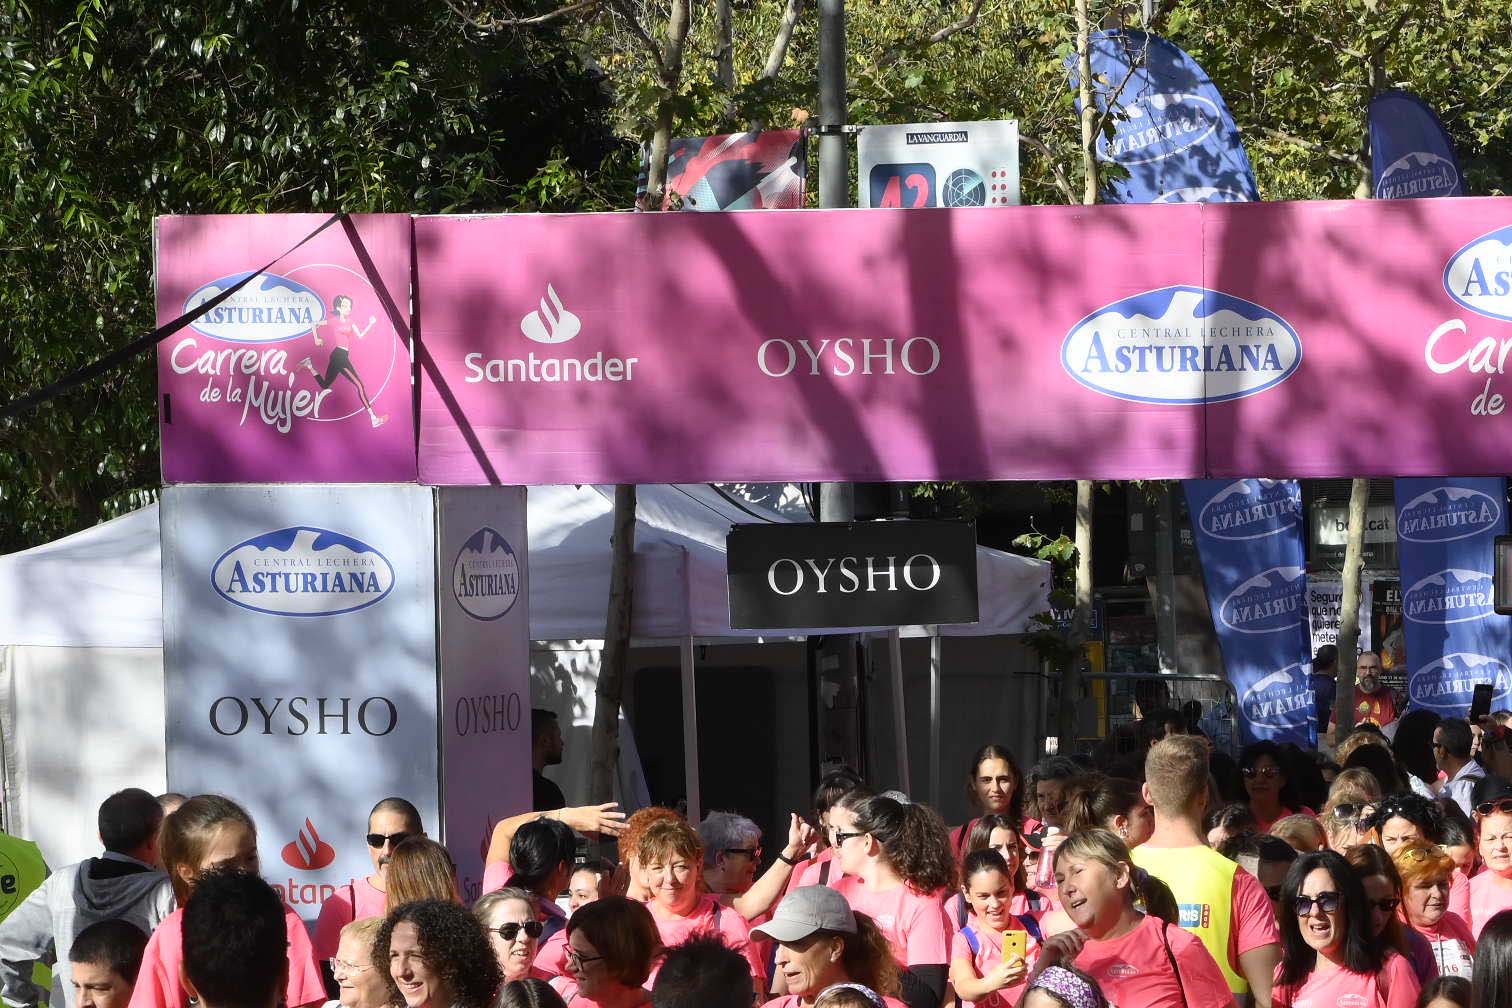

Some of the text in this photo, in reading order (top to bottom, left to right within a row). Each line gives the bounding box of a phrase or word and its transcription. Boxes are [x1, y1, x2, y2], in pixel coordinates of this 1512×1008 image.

[917, 132, 967, 143] VANGUARDIA
[1117, 325, 1275, 339] CENTRAL LECHERA
[170, 337, 288, 376] Carrera
[464, 351, 639, 384] Santander
[757, 336, 941, 378] OYSHO
[1081, 330, 1283, 375] ASTURIANA
[200, 372, 333, 434] de la Mujer
[1470, 377, 1506, 417] de
[226, 560, 382, 594] ASTURIANA
[254, 557, 376, 568] CENTRAL LECHERA
[768, 553, 941, 596] OYSHO
[458, 564, 517, 599] ASTURIANA
[1312, 606, 1328, 618] que
[1312, 618, 1343, 632] quiere
[208, 695, 399, 737] OYSHO
[455, 691, 521, 738] OYSHO
